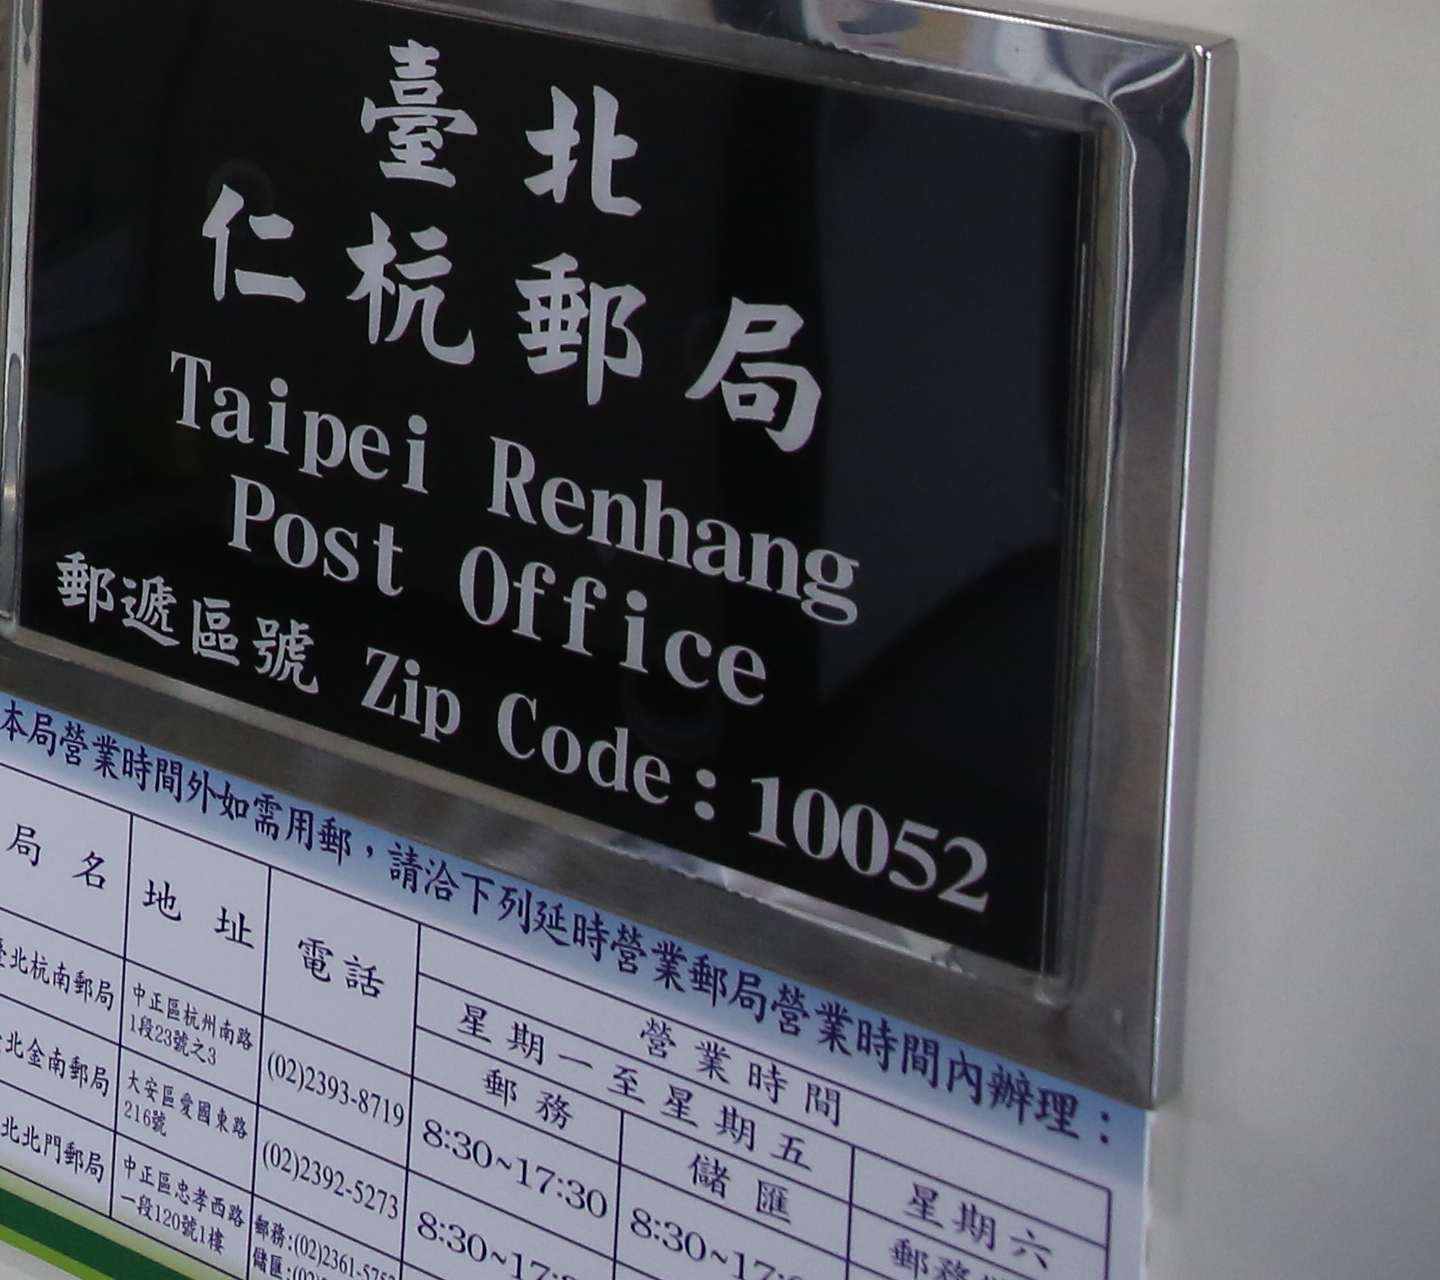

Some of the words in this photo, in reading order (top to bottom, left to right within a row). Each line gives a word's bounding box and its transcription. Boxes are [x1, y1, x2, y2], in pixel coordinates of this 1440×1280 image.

[359, 38, 644, 220] 臺北
[200, 183, 825, 454] 仁杭郵局
[169, 351, 431, 497] Taipei
[487, 434, 863, 628] Renhang
[228, 474, 406, 597] Post
[457, 542, 770, 709] Office
[53, 550, 321, 698] 郵遞區號
[361, 643, 463, 744] Zip
[747, 775, 992, 913] 10052
[6, 823, 108, 891] 局名
[142, 880, 256, 950] 地址
[297, 936, 385, 1000] 電話
[130, 1014, 217, 1065] 1段23號之3
[132, 982, 255, 1052] 中正區杭州南路
[127, 1069, 250, 1140] 大安區愛國東路
[267, 1051, 406, 1128] (02)2393-8719
[457, 1001, 812, 1172] 星期一至星期五
[481, 1068, 575, 1130] 郵務
[639, 1016, 842, 1128] 營業時間
[124, 1101, 168, 1138] 216號
[123, 1154, 246, 1229] 中正區忠孝西路
[262, 1140, 399, 1221] (02)2392-5273
[422, 1119, 608, 1219] 8:30~17:30
[688, 1152, 792, 1225] 儲匯
[906, 1181, 1053, 1270] 星期六
